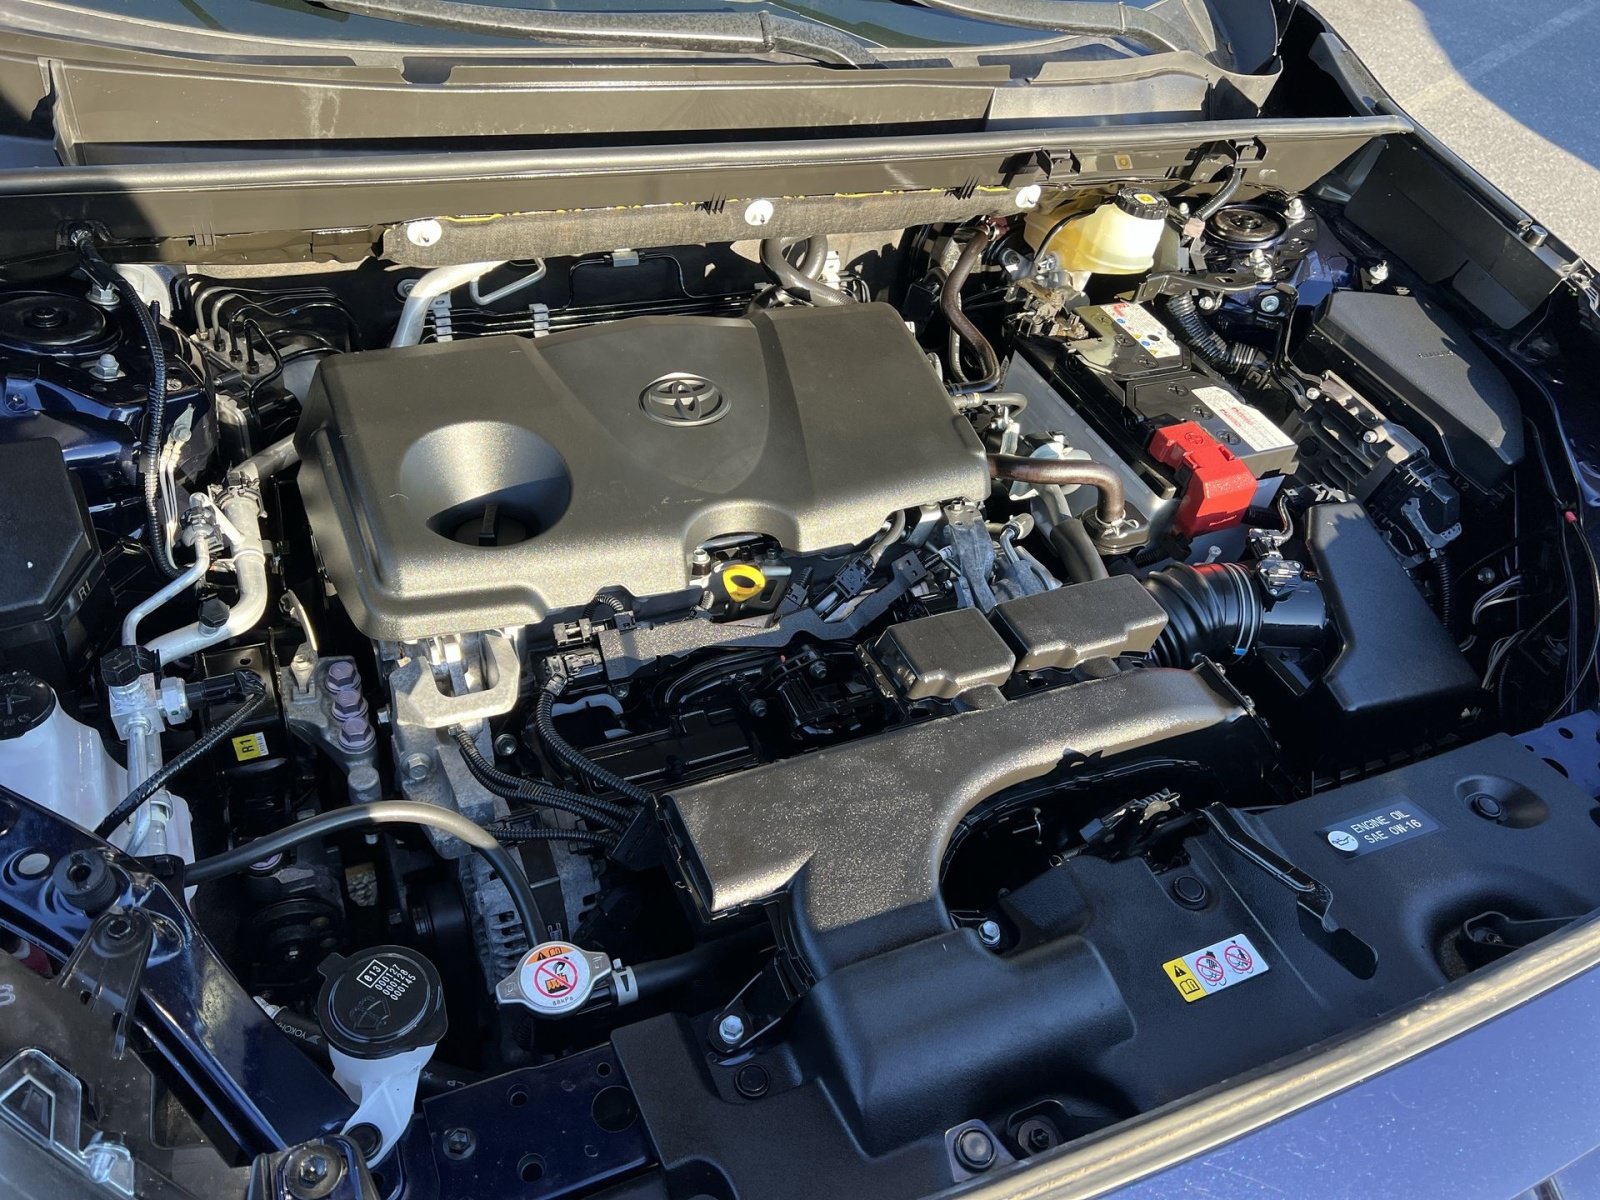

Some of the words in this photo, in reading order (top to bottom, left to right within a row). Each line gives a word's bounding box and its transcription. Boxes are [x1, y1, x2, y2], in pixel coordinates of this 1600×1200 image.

[78, 580, 91, 601] R1
[239, 739, 255, 753] R1
[1350, 815, 1391, 834] ENGINE
[1389, 809, 1411, 820] OIL
[1363, 830, 1389, 844] SAE
[374, 963, 400, 991] 000127
[382, 969, 409, 996] 000128
[390, 973, 416, 1001] 000145
